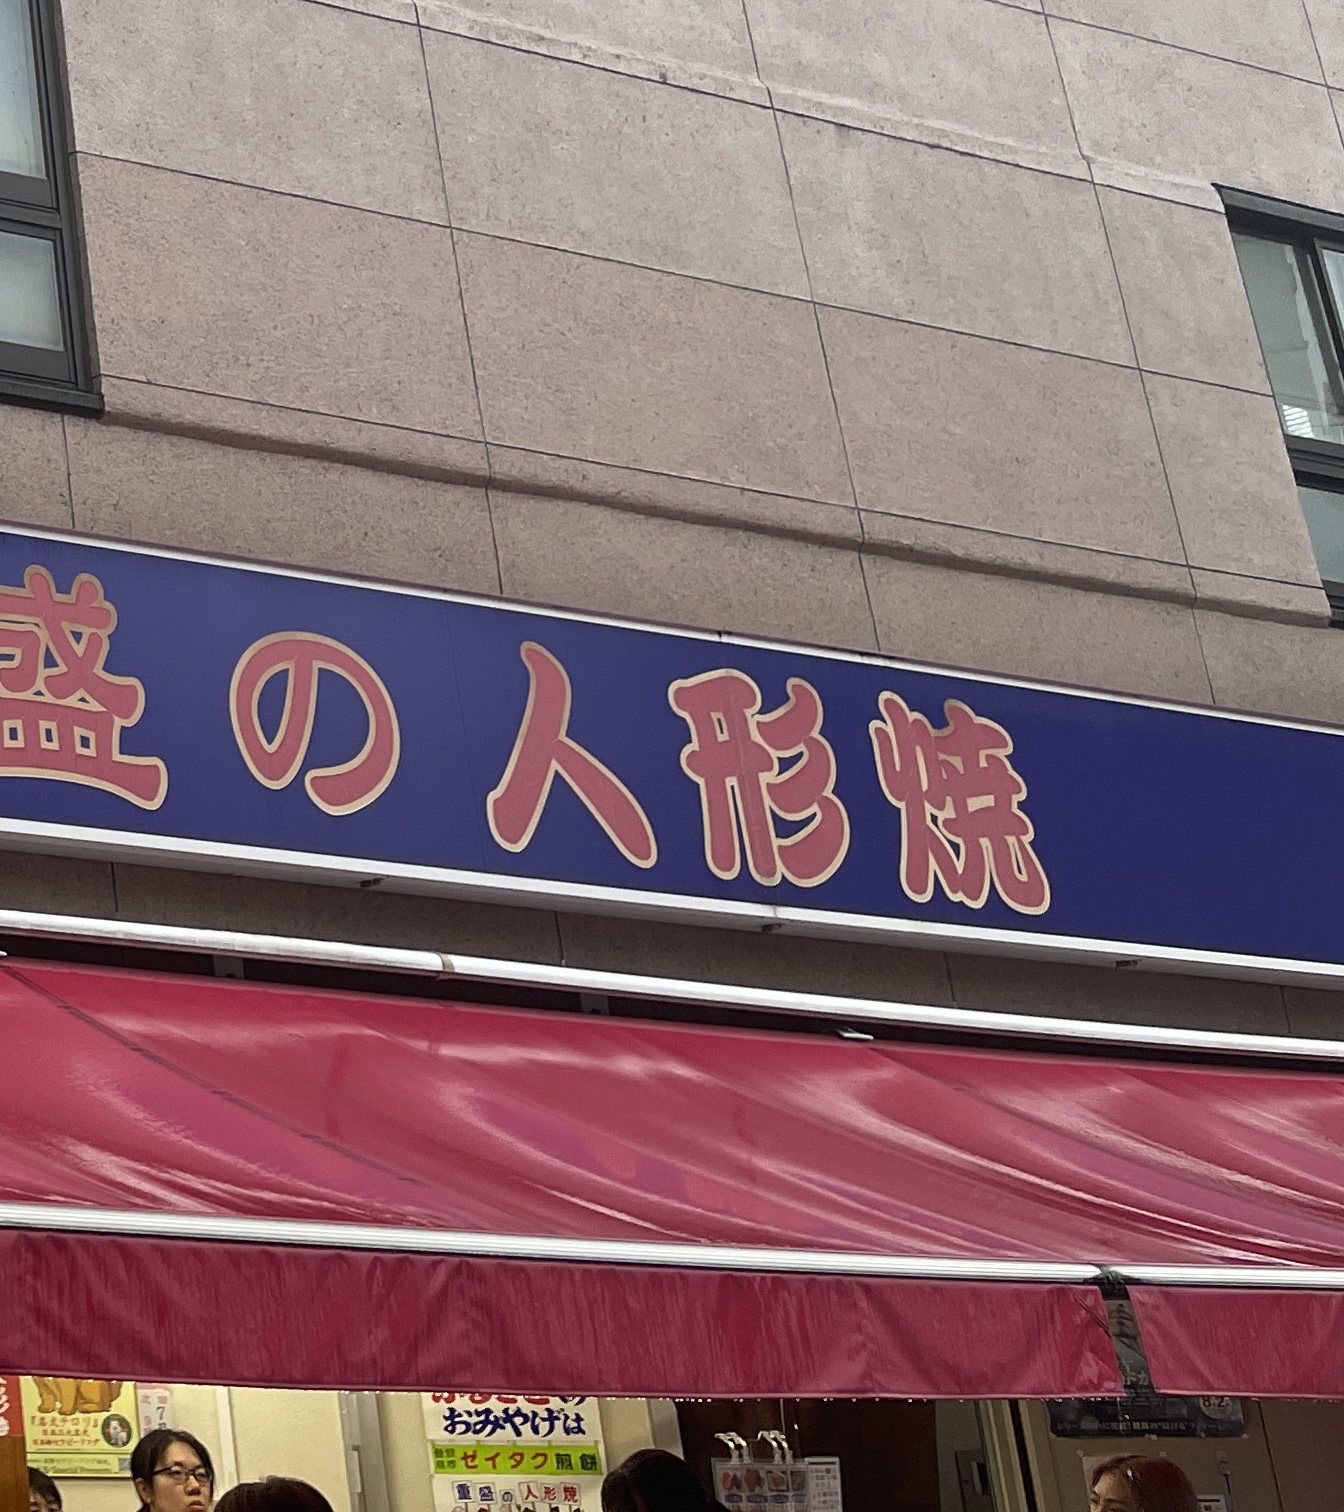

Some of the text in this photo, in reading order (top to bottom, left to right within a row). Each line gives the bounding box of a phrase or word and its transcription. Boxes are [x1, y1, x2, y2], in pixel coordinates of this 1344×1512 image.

[443, 1406, 586, 1437] おみやげは
